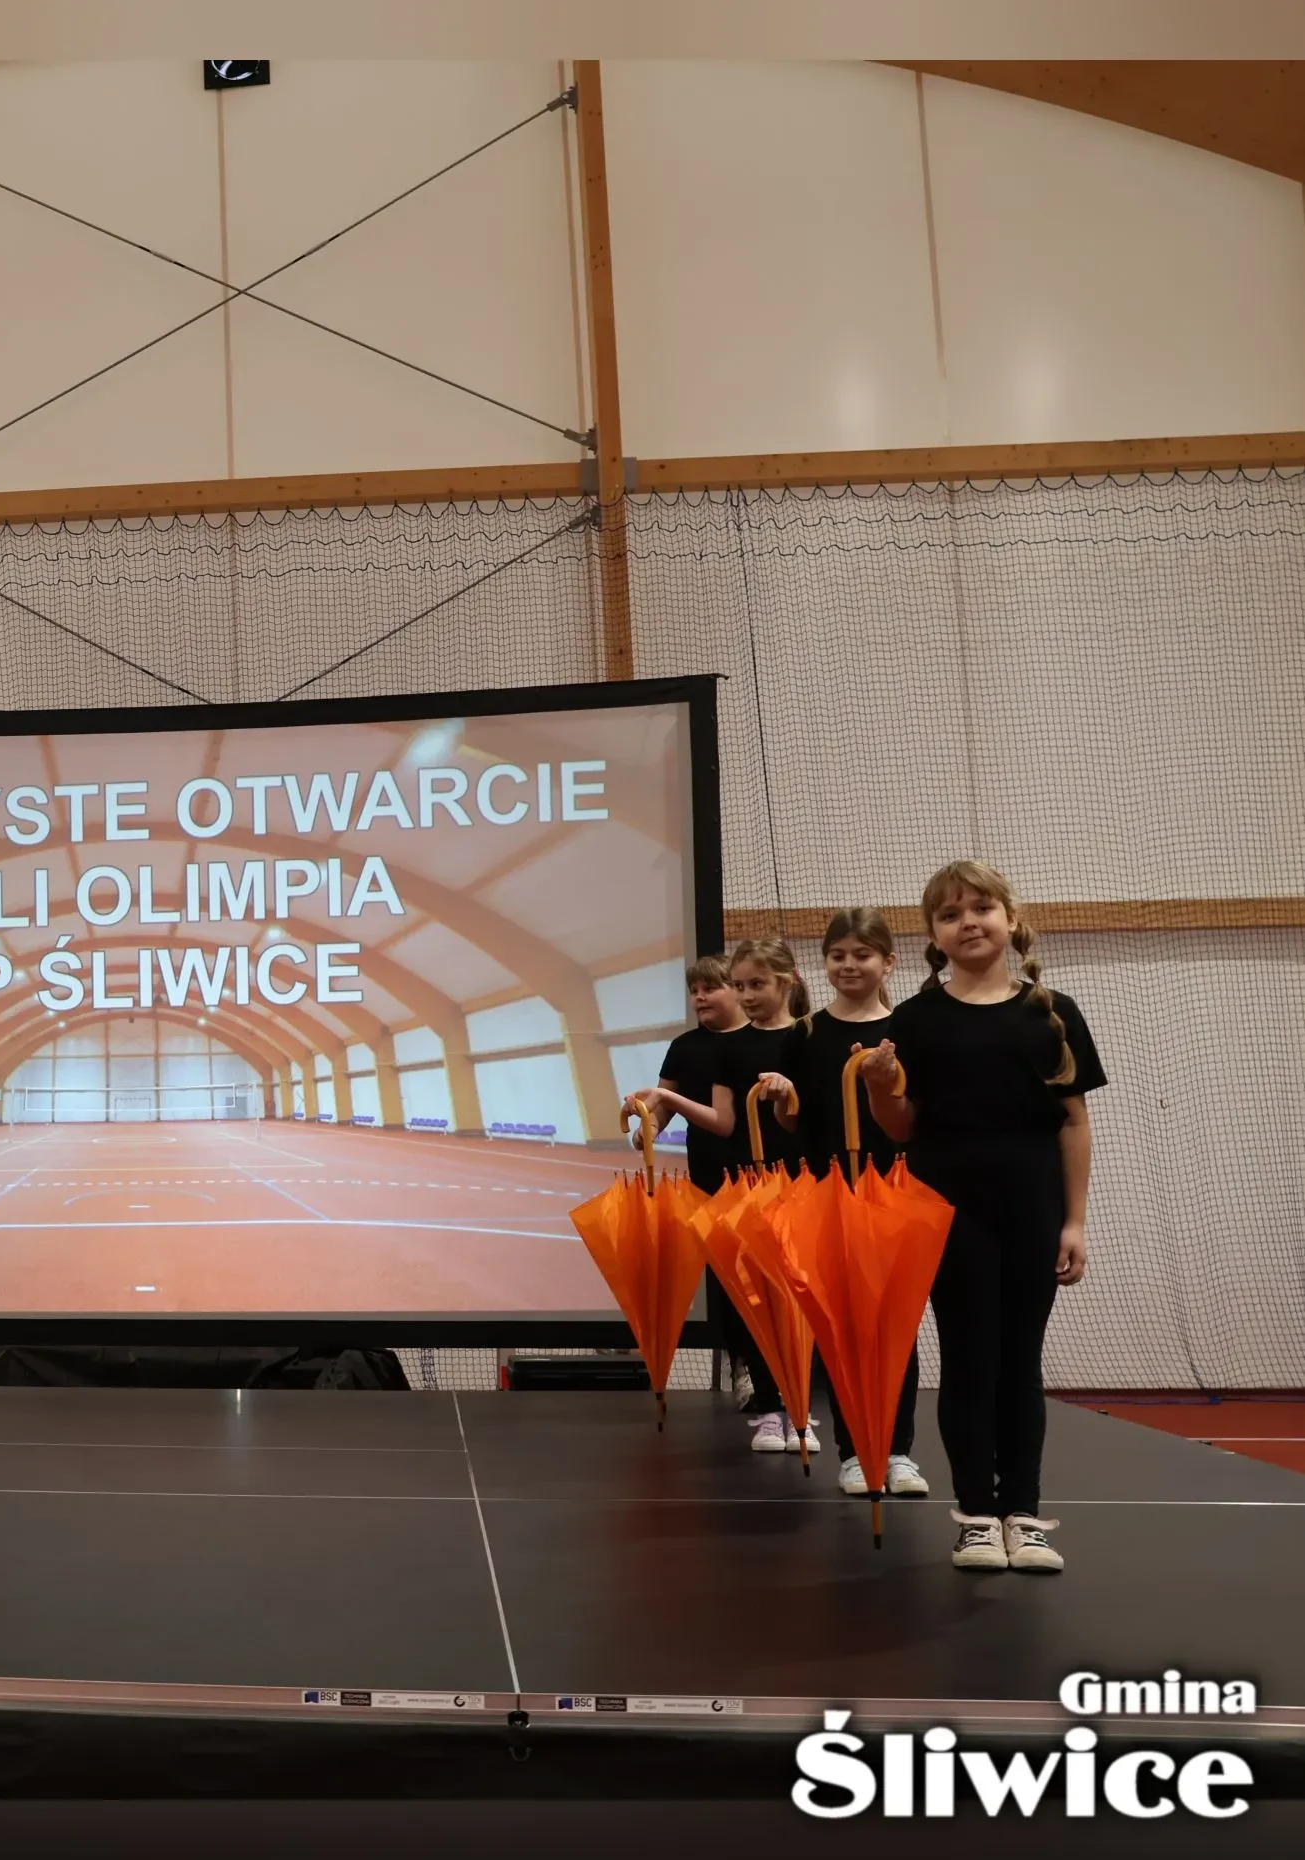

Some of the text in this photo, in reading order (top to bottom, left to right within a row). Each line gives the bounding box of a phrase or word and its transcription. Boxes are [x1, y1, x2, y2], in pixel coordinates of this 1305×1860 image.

[175, 759, 609, 838] OTWARCIE
[75, 856, 405, 926] OLIMPIA
[37, 935, 363, 1013] ŚLIWICE
[320, 1691, 338, 1702] BSC
[574, 1697, 593, 1708] BSC
